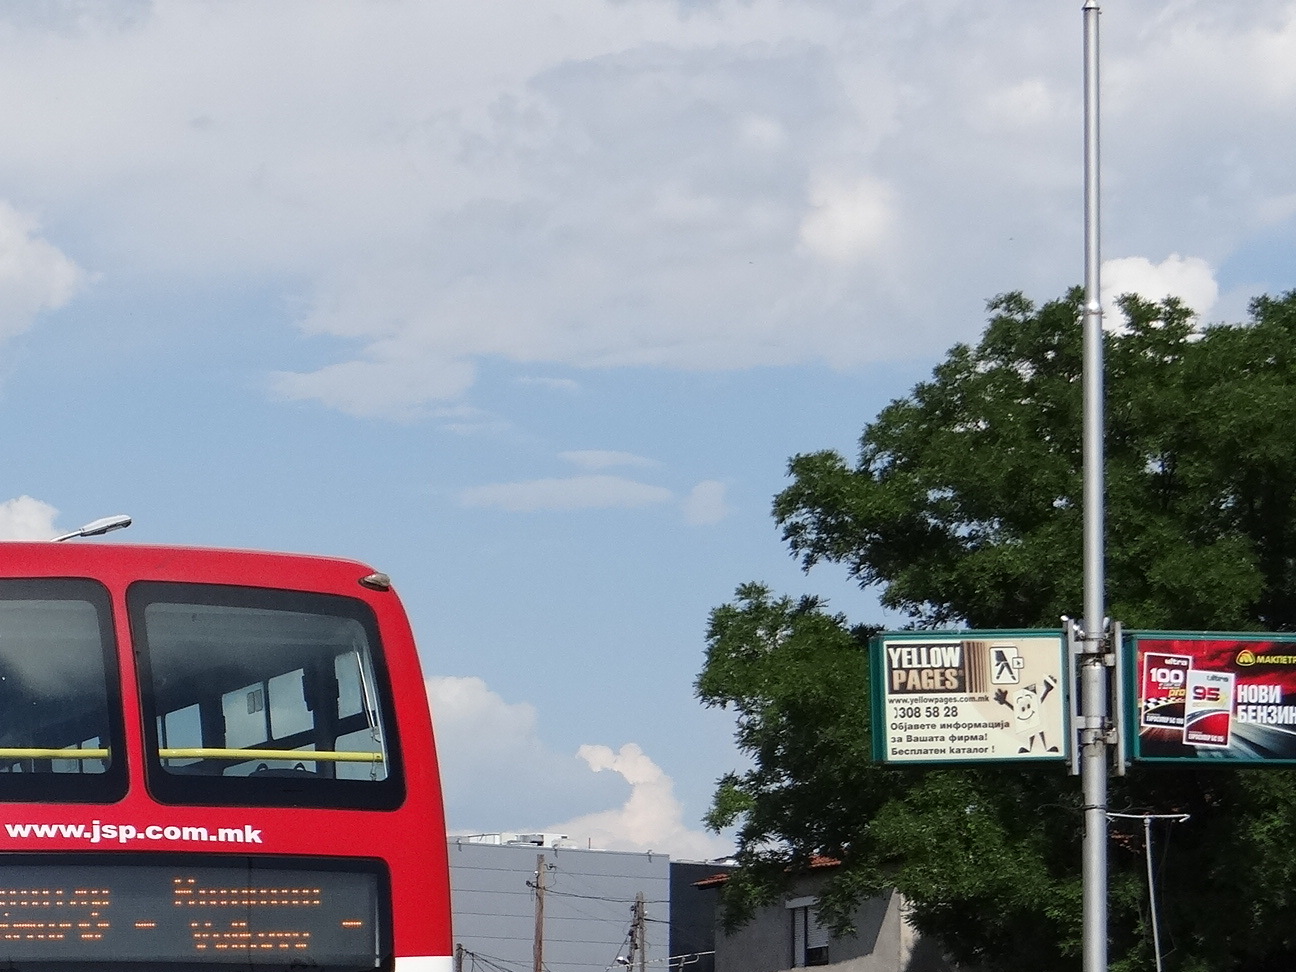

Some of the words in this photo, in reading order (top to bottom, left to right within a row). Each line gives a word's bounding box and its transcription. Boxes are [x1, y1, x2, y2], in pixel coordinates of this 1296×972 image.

[888, 646, 961, 669] YELLOW
[892, 669, 960, 691] PAGES
[1149, 667, 1184, 684] 100
[888, 695, 990, 706] www.yellowpages.com.mk
[1192, 685, 1221, 702] 95
[1237, 684, 1281, 704] НОВИ
[925, 706, 940, 718] 58
[943, 705, 959, 718] 28
[890, 722, 937, 732] Објавете
[939, 720, 1010, 732] информација
[905, 734, 945, 743] Вашата
[948, 732, 988, 743] фирма!
[891, 747, 946, 755] Бесплатен
[5, 820, 263, 844] www.jsp.com.mk
